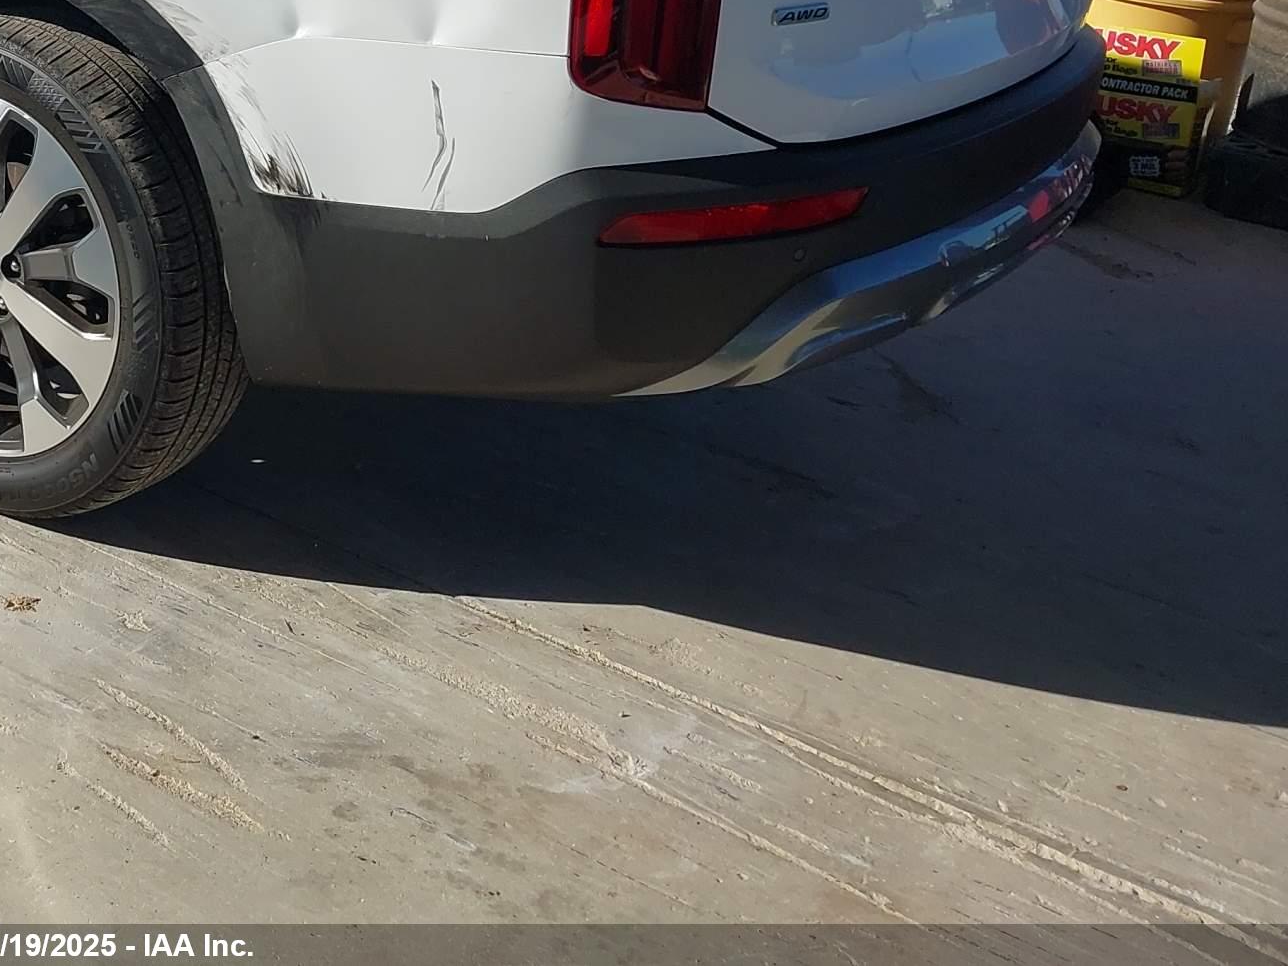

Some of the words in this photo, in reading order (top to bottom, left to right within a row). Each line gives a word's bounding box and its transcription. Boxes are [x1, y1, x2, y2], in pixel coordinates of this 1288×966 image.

[778, 7, 829, 23] AWD
[1094, 28, 1181, 60] USKY
[1100, 77, 1161, 96] ONTRACTOR
[1161, 87, 1189, 100] PACK
[1096, 94, 1178, 123] USKY
